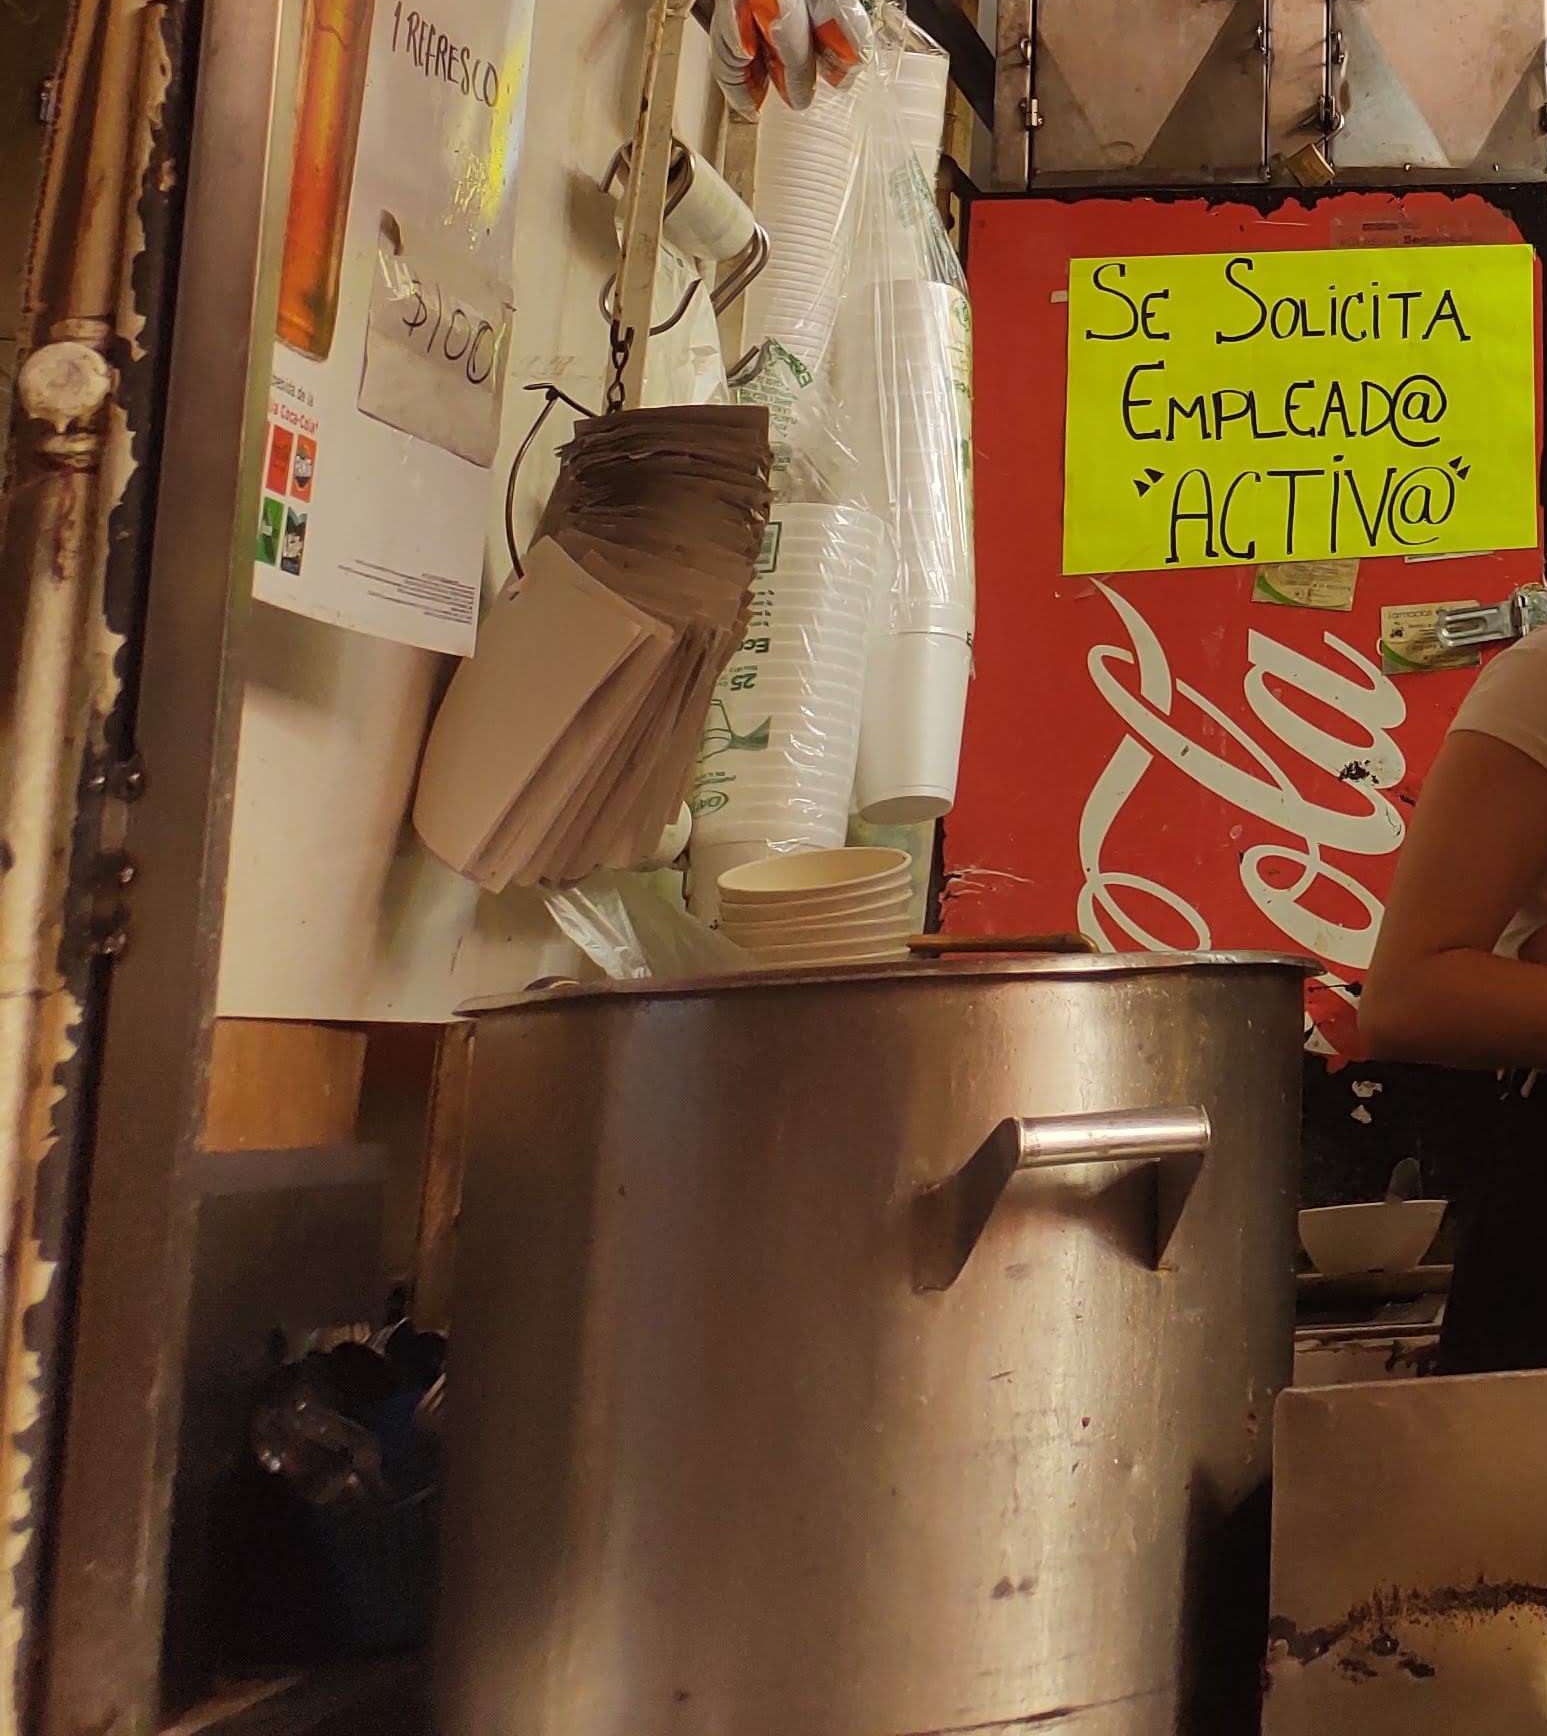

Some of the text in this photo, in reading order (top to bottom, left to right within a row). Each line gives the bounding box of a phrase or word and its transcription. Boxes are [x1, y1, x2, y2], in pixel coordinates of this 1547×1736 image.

[392, 0, 501, 108] 1 REFRESCO
[1214, 257, 1472, 346] SOLICITA
[1121, 359, 1448, 448] EMPLEAD@
